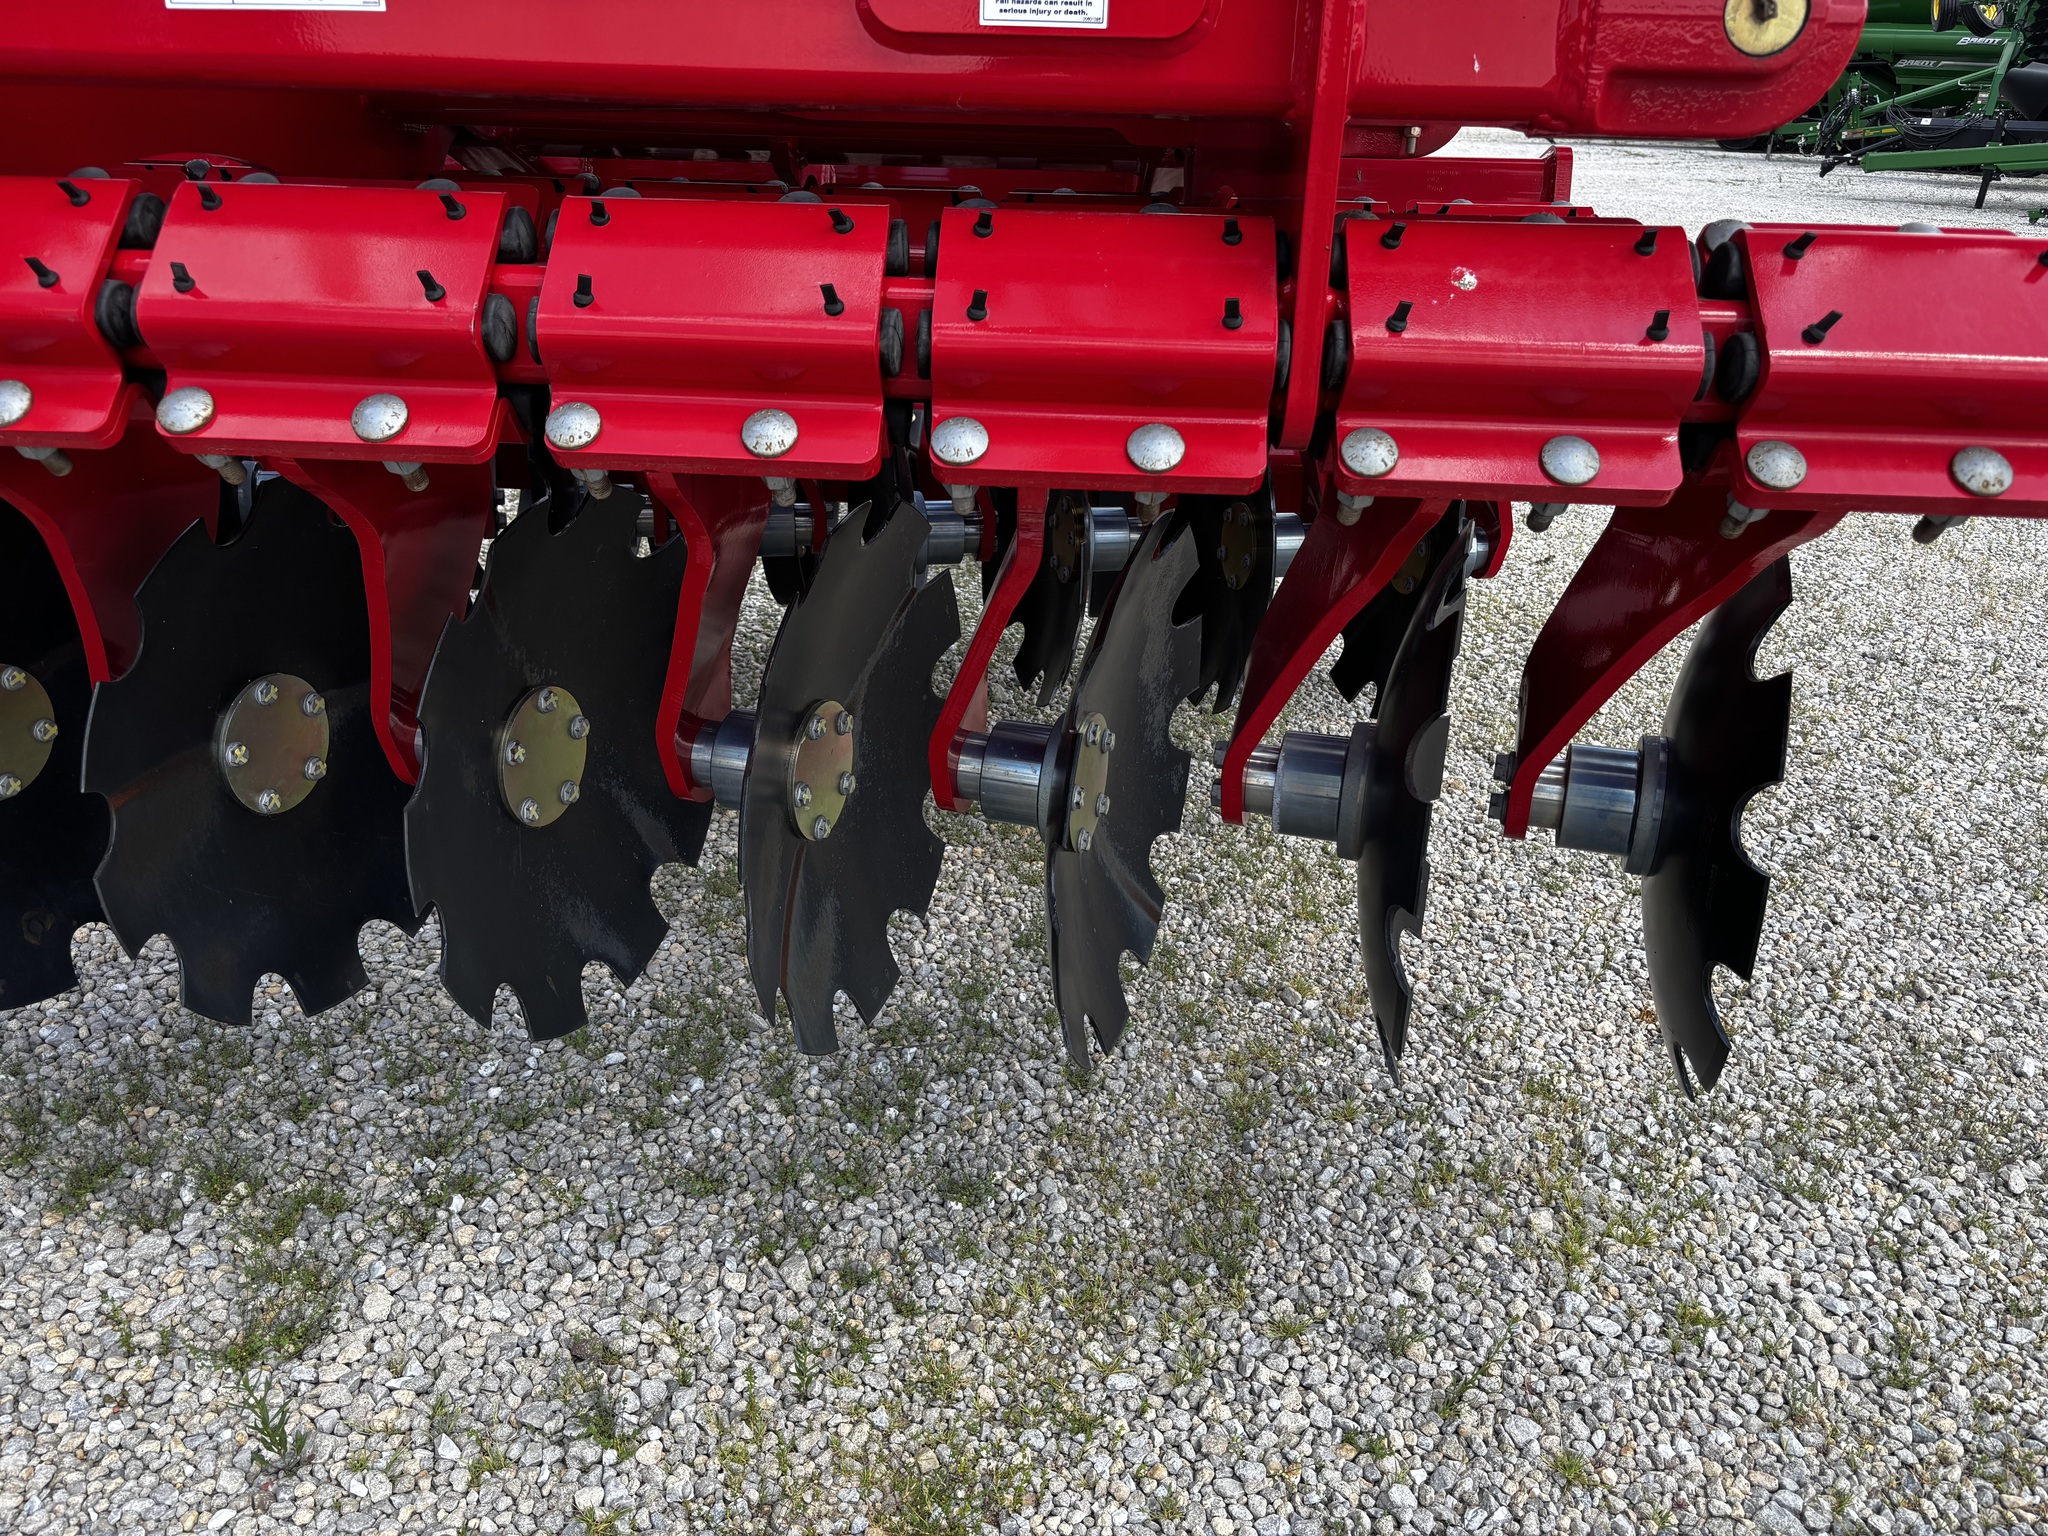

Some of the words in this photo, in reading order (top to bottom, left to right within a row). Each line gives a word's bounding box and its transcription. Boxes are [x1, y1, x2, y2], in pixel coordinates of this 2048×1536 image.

[1029, 7, 1052, 17] injury
[1956, 36, 2002, 46] BRENT
[1894, 59, 1938, 68] BRENT
